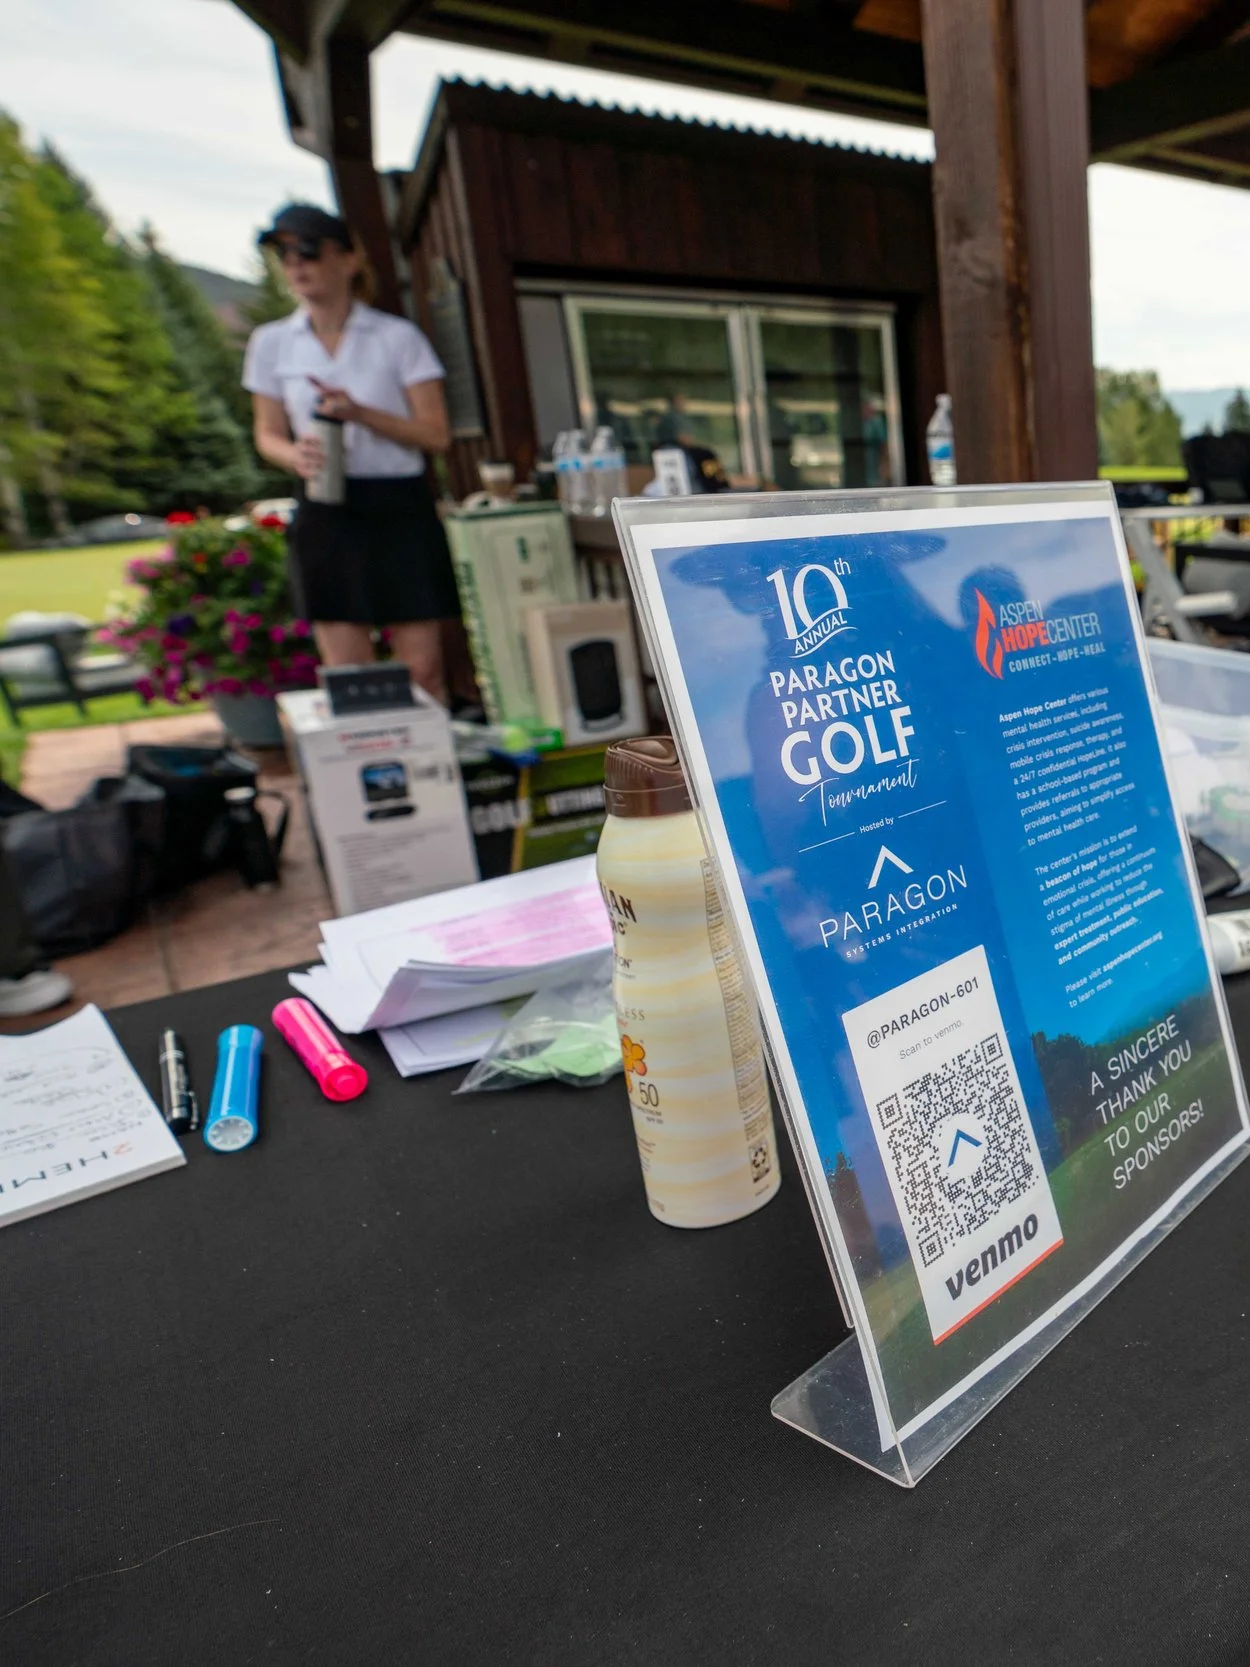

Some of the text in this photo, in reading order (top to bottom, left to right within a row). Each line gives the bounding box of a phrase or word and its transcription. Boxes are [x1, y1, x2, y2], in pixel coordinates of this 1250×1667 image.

[795, 611, 848, 654] ANNUAL
[1000, 600, 1044, 627] ASPEN
[769, 650, 896, 698] PARAGON
[781, 679, 903, 729] PARTNER
[999, 687, 1109, 723] Aspen Hope Center offers various
[1003, 724, 1028, 738] mental
[1029, 718, 1052, 730] health
[1081, 701, 1108, 715] including
[781, 705, 915, 786] GOLF
[1006, 742, 1025, 754] crisis
[1070, 722, 1090, 734] suicide
[1010, 755, 1034, 769] mobile
[1035, 749, 1054, 761] crisis
[1111, 726, 1123, 737] and
[1016, 790, 1030, 800] has
[1037, 771, 1082, 793] school-based
[1082, 762, 1108, 778] program
[1109, 757, 1120, 768] and
[1019, 770, 1036, 783] 24/7
[1037, 757, 1077, 777] confidential
[1114, 741, 1127, 751] also
[798, 758, 920, 827] Tournament
[1020, 772, 1123, 818] provides referrals to appropriate
[1024, 782, 1136, 833] providers, aiming to simplify access
[859, 816, 894, 834] Hosted by
[1027, 837, 1036, 847] to
[1037, 826, 1063, 842] mental
[1063, 817, 1084, 832] health
[1034, 824, 1138, 875] The center's mission is to extend
[1039, 884, 1045, 892] a
[1045, 871, 1072, 889] beacon
[1072, 865, 1080, 876] of
[1081, 859, 1098, 872] hope
[1098, 854, 1108, 863] for
[1108, 847, 1126, 859] those
[819, 864, 968, 949] PARAGON
[1043, 884, 1077, 906] emotional
[1097, 864, 1120, 880] offering
[1046, 863, 1153, 921] of care while working to reduce the
[846, 903, 958, 959] SYSTEMS INTEGRATION
[1050, 919, 1074, 936] stigma
[1074, 913, 1081, 923] of
[1082, 901, 1105, 919] mental
[1054, 932, 1078, 951] expert
[1113, 903, 1132, 920] public
[1058, 951, 1072, 965] and
[1073, 933, 1109, 957] community
[1065, 977, 1087, 993] Please
[1088, 967, 1102, 980] visit
[1069, 999, 1078, 1008] to
[1077, 988, 1095, 1003] learn
[867, 976, 979, 1049] @PARAGON-601
[899, 1019, 965, 1059] Scan to venmo.
[1091, 1014, 1179, 1096] A SINCERE
[639, 1081, 659, 1107] 50
[1096, 1039, 1191, 1125] THANK YOU
[1104, 1093, 1171, 1157] TO OUR
[1113, 1098, 1204, 1189] SPONSORS!
[945, 1213, 1038, 1301] venmo
